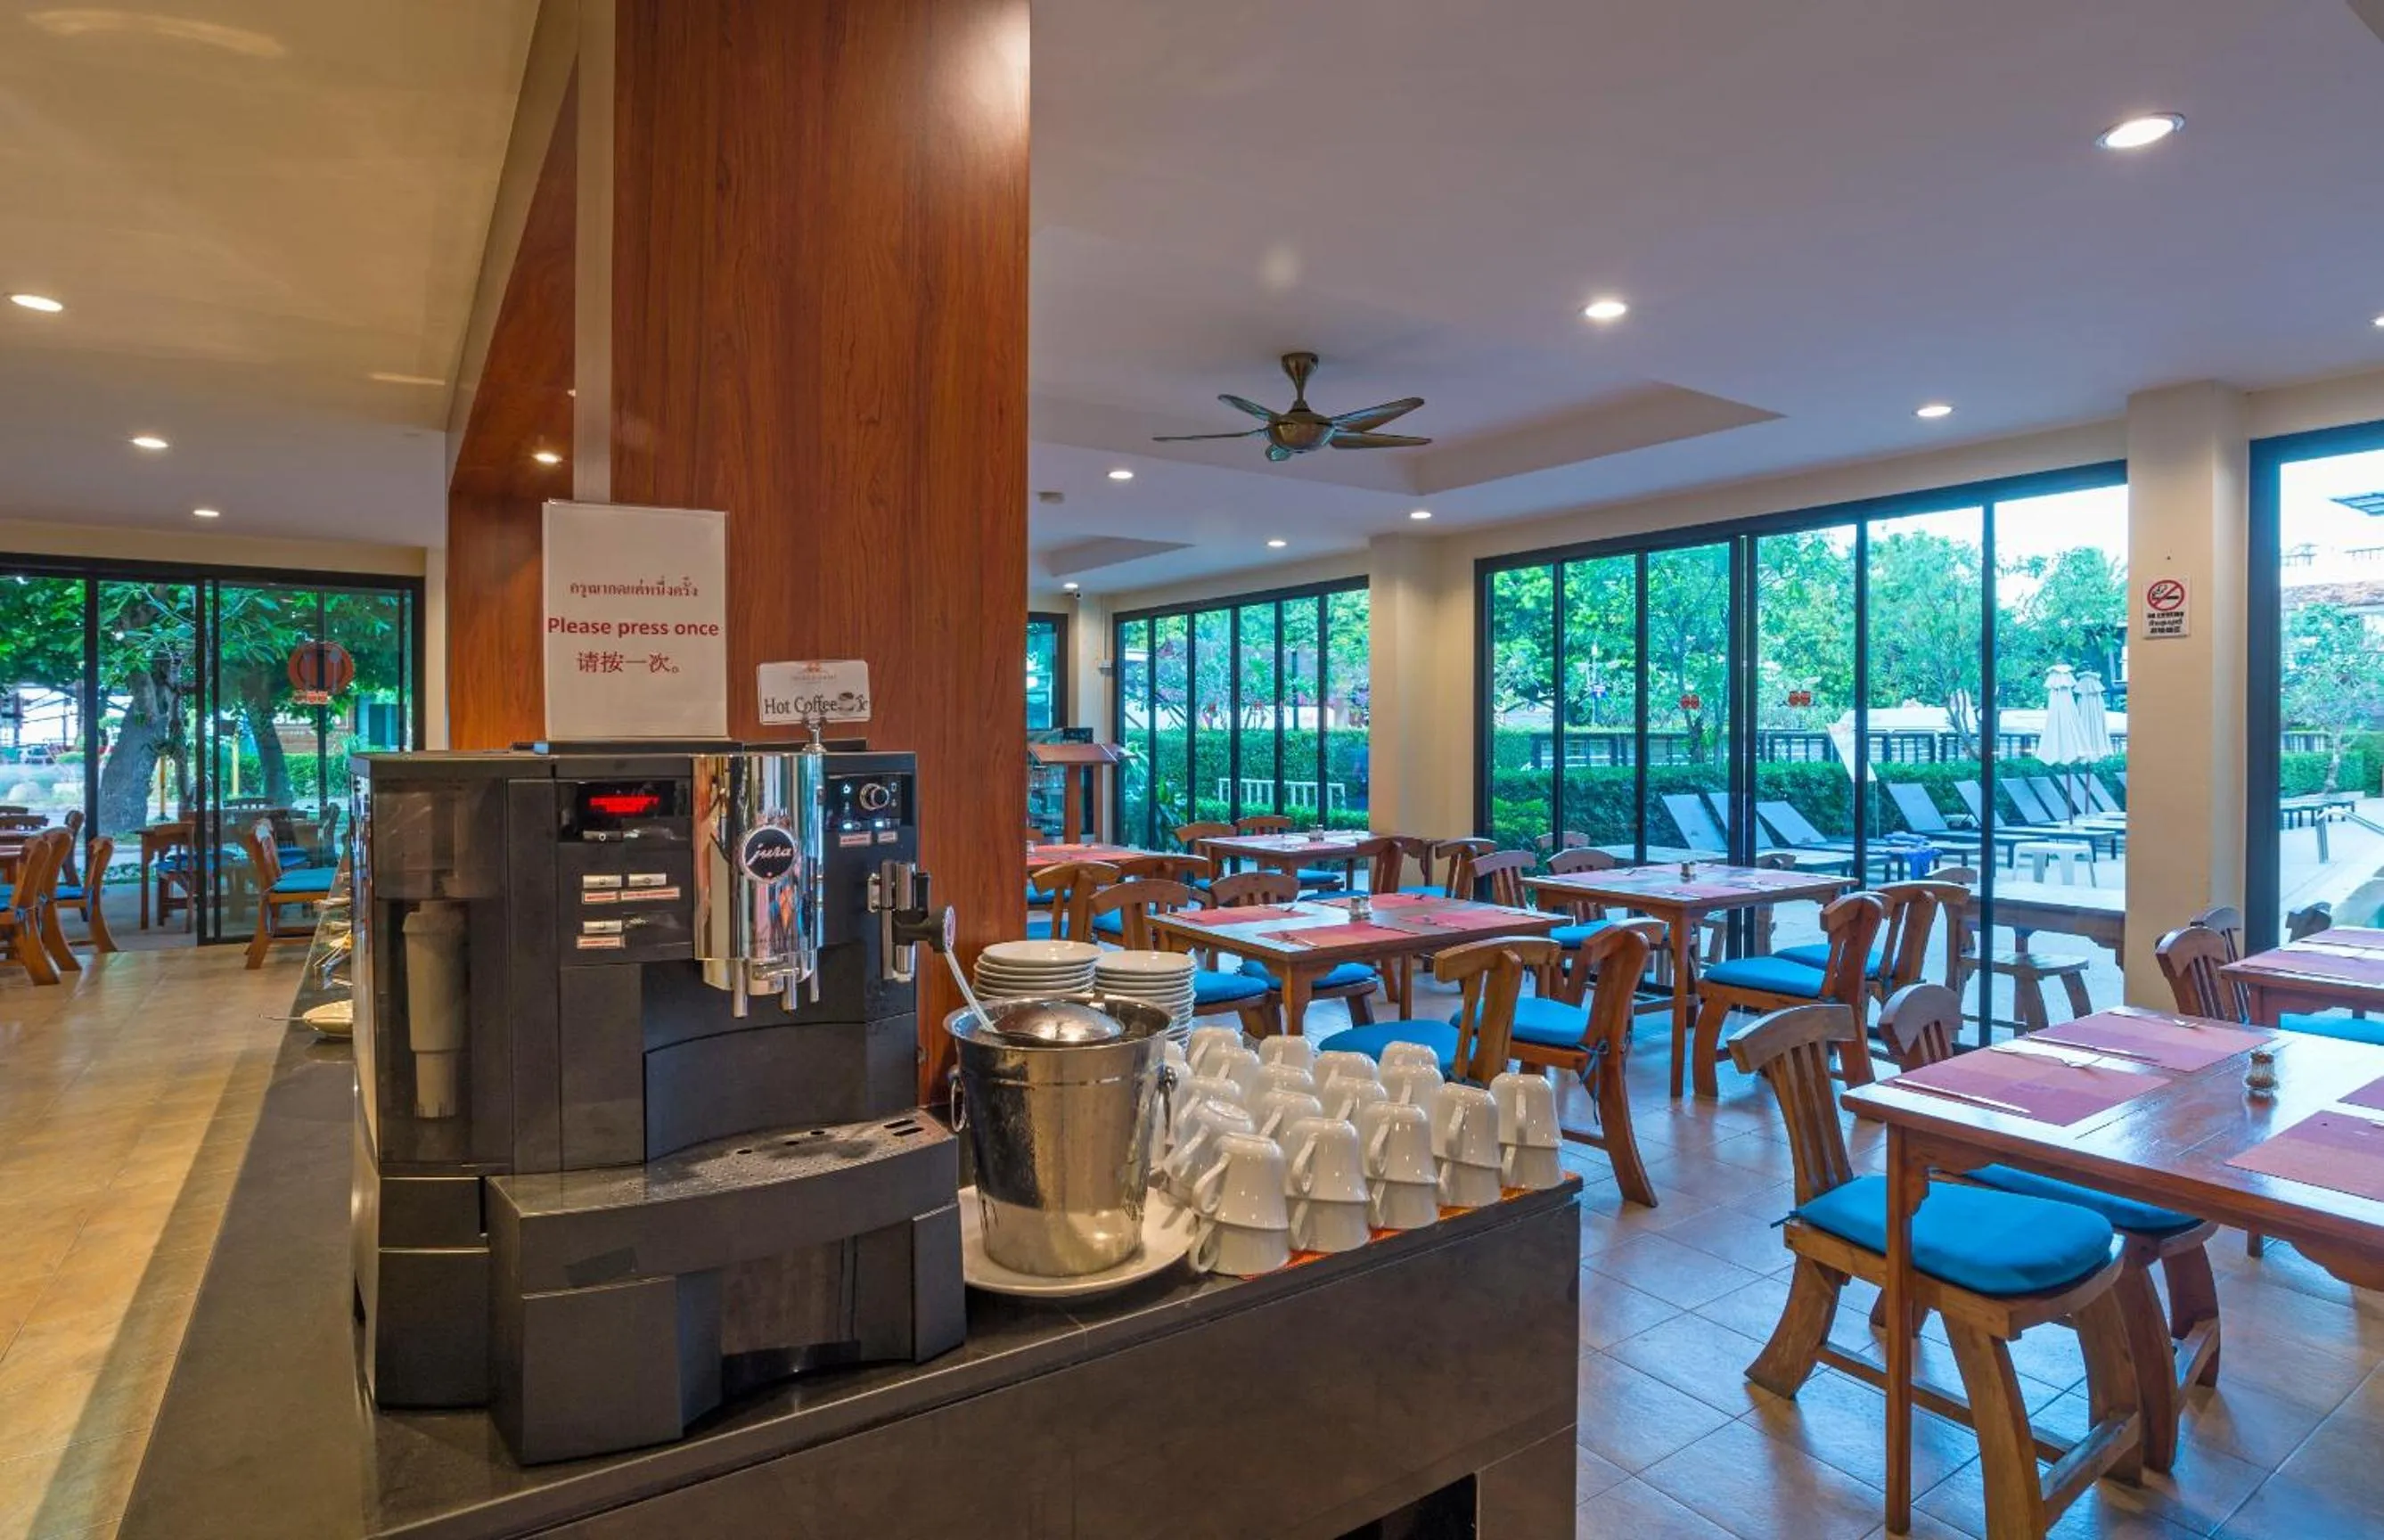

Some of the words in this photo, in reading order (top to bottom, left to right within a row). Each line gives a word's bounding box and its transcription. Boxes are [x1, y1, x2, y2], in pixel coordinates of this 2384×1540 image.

[547, 617, 612, 635] Please
[617, 621, 669, 639] press
[674, 623, 720, 636] once
[576, 650, 681, 675] 请按一次。
[764, 697, 791, 715] Hot
[793, 693, 838, 715] Coffee
